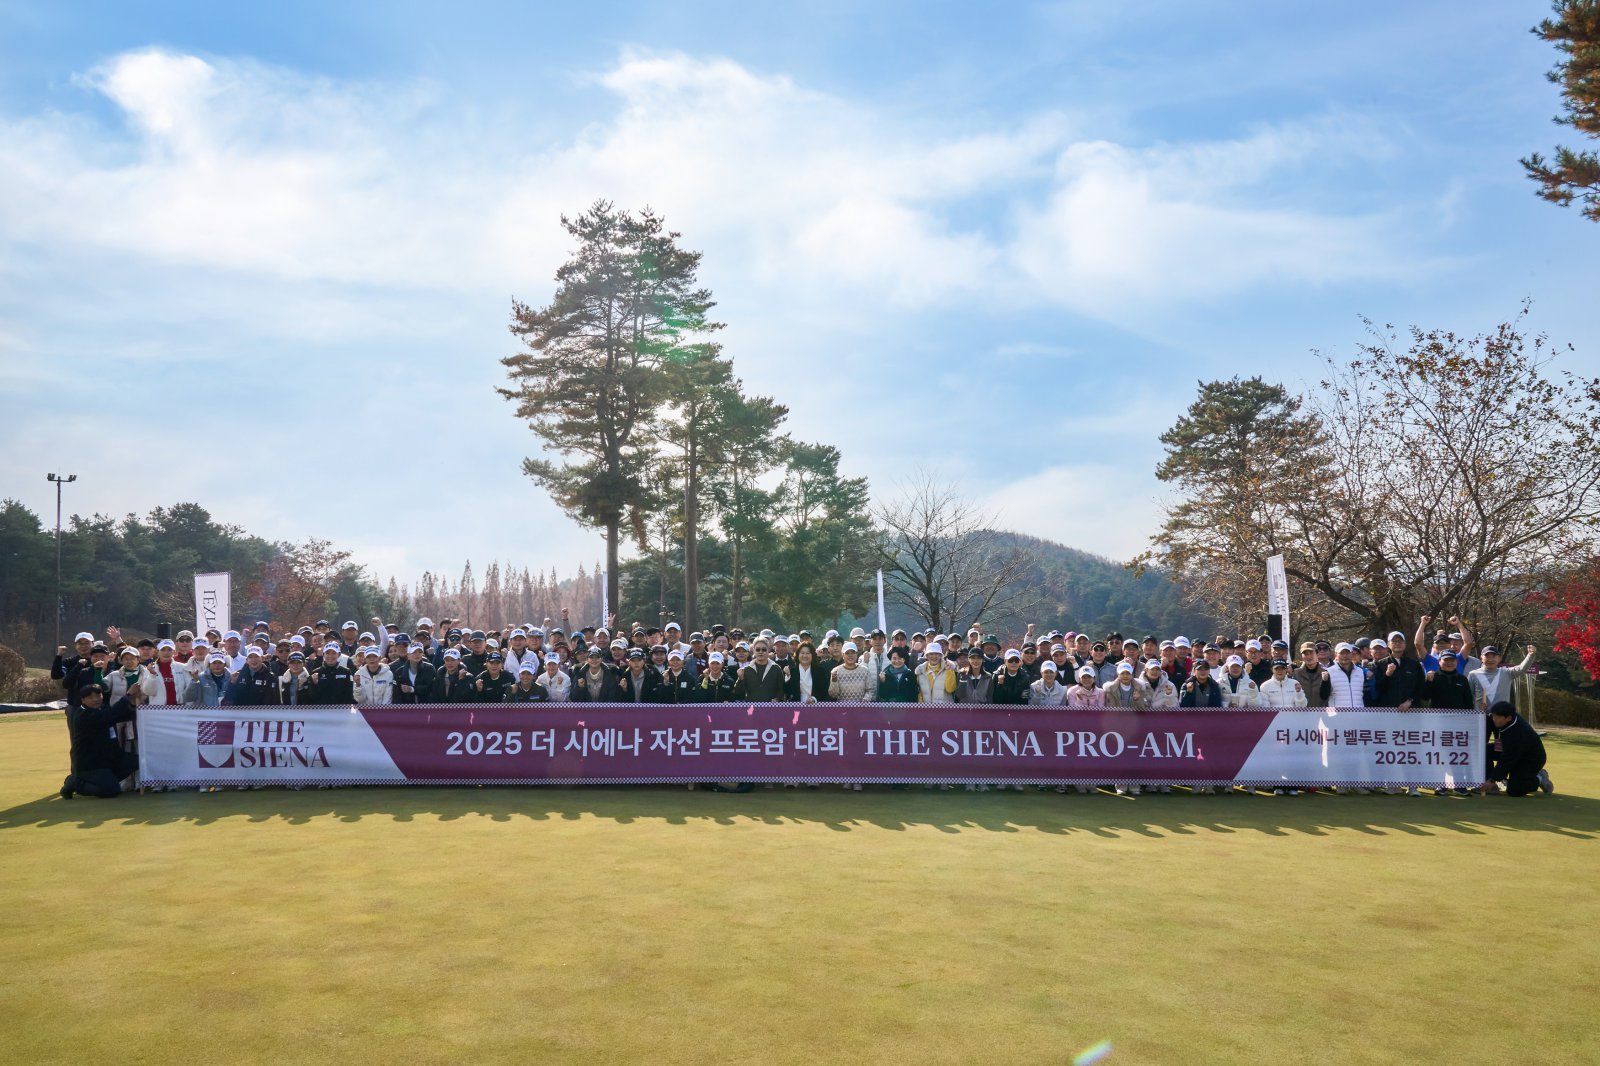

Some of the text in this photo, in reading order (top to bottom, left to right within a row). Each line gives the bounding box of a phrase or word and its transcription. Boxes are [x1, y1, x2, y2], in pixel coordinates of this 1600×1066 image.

[240, 720, 305, 743] THE
[446, 726, 1196, 758] 2025 더 시에나 자선 프로암 대회 THE SIENA PRO-AM
[1276, 728, 1470, 747] 더 시에나 벨루토 컨트리 클럽
[239, 746, 331, 769] SIENA
